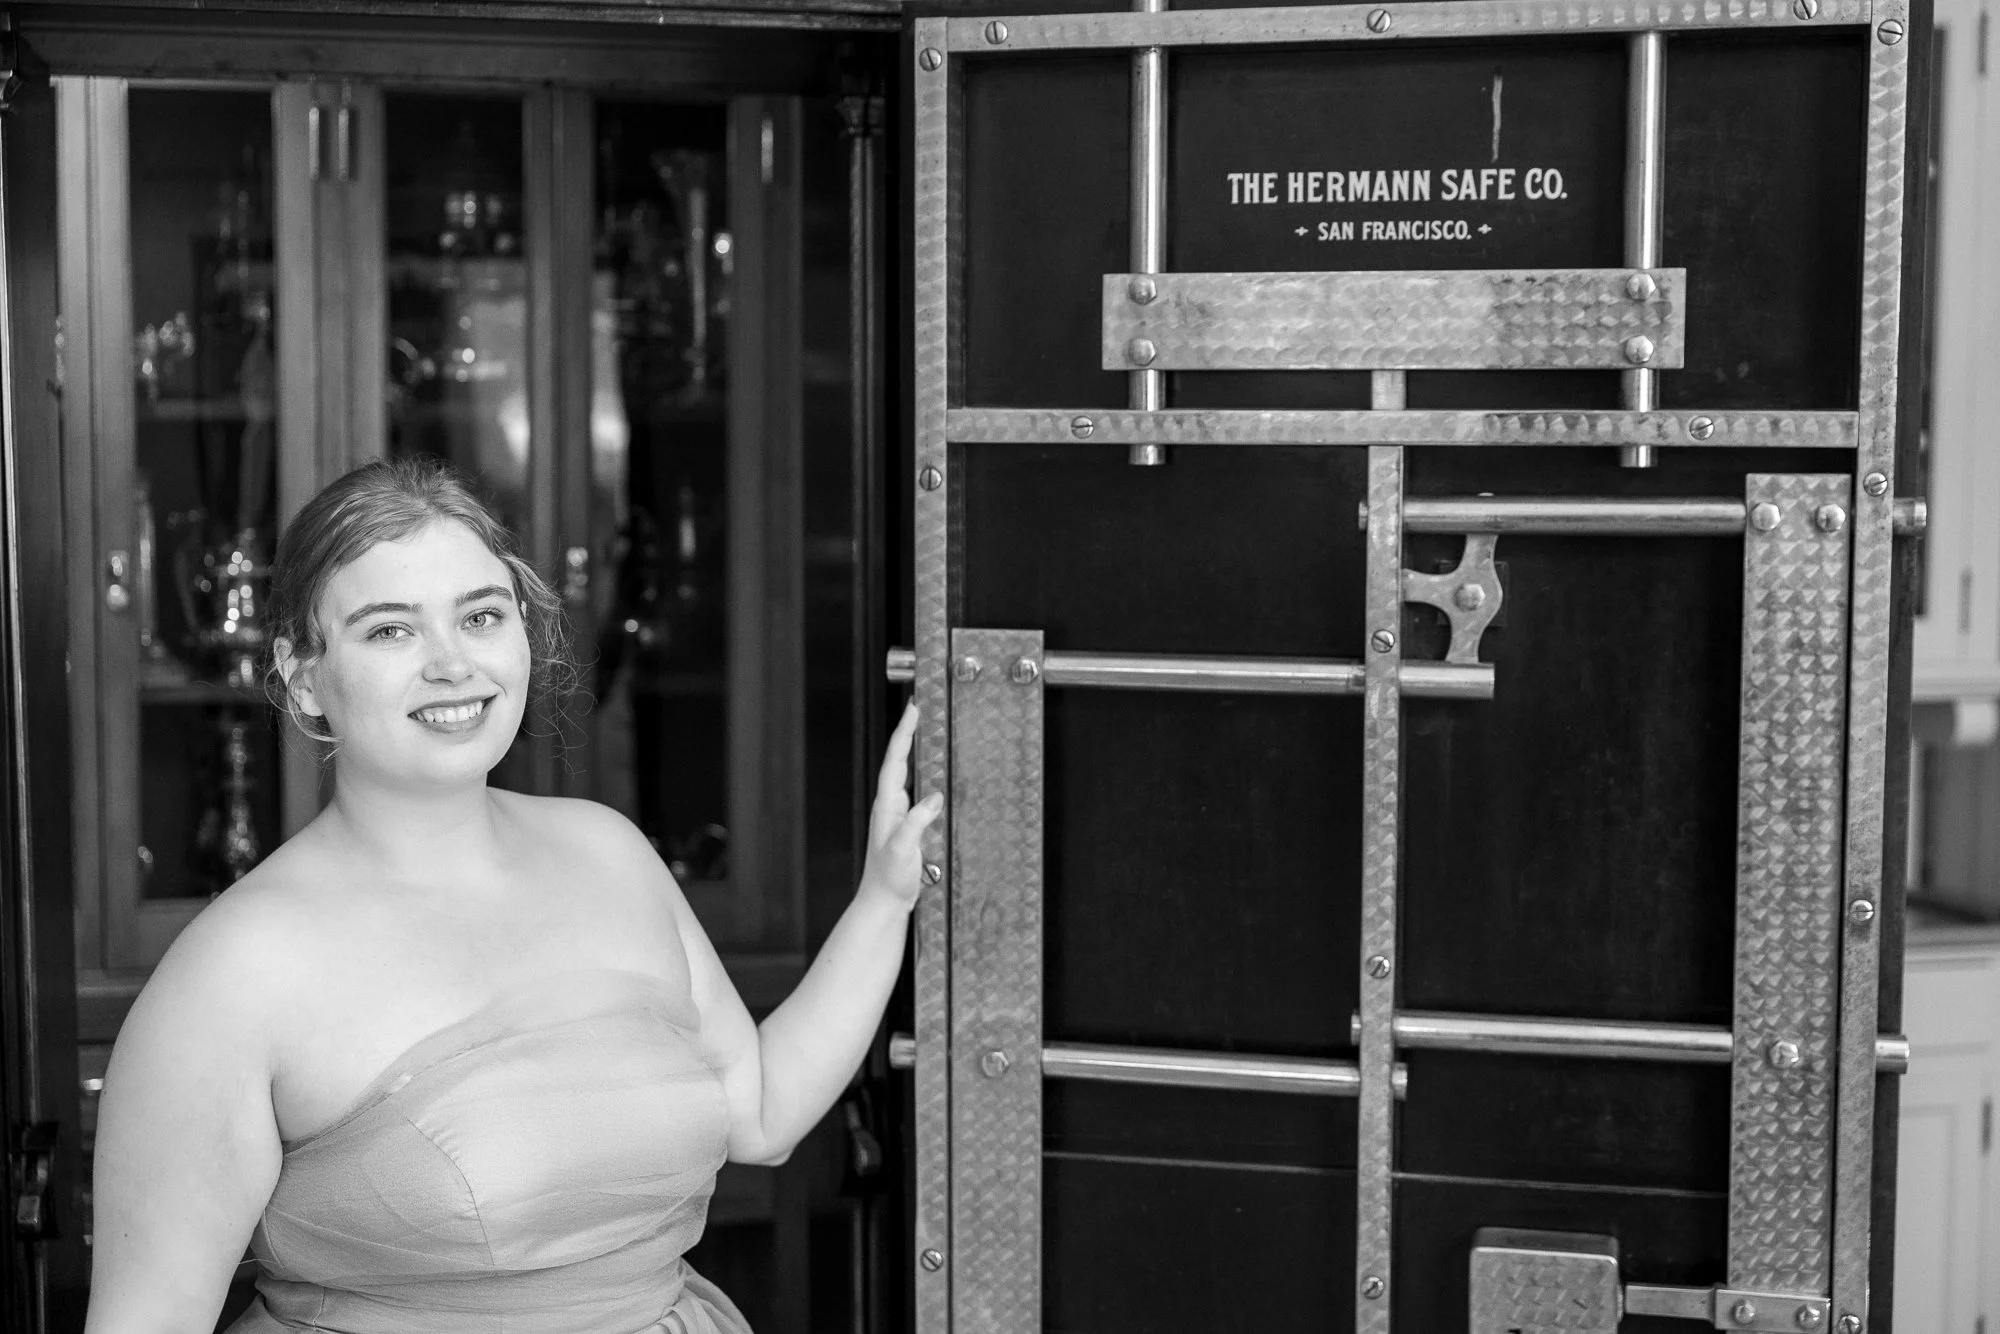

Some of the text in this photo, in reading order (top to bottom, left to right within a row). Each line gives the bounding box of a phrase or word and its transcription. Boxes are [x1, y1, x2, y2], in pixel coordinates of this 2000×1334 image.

[1227, 167, 1568, 205] THE HERMANN SAFE CO.
[1317, 219, 1472, 241] SAN FRANCISCO.
